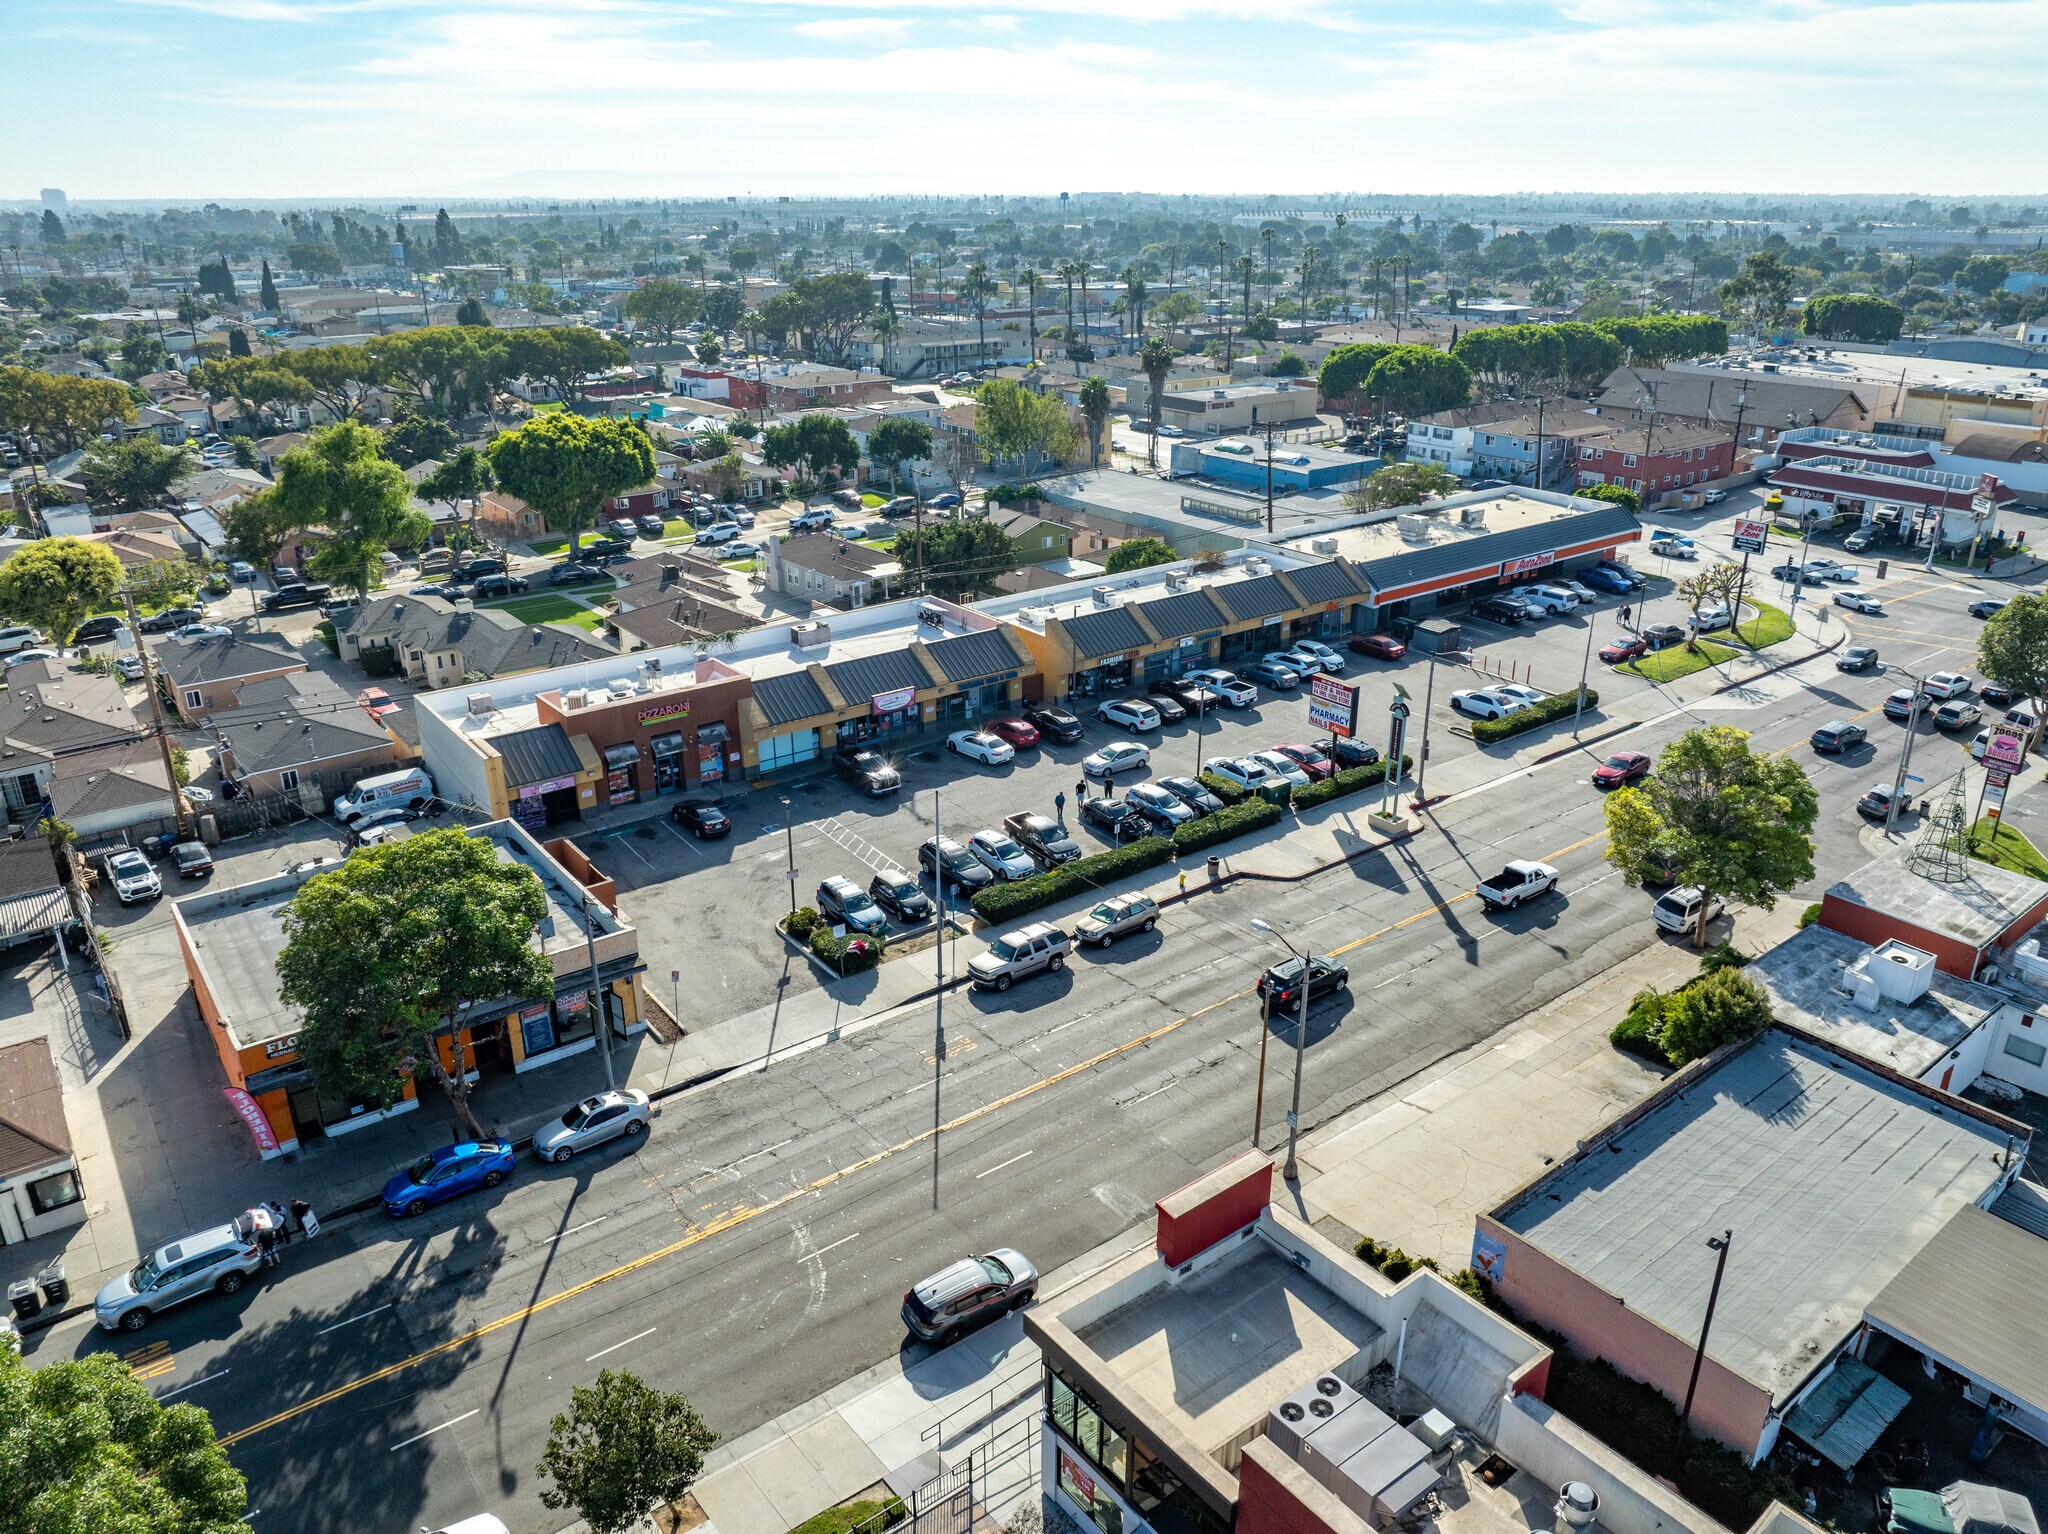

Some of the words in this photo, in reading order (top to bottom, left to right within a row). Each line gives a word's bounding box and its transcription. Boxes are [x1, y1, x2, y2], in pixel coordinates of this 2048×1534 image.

[1740, 529, 1760, 539] Zone
[1745, 523, 1764, 532] Auto
[1517, 554, 1552, 570] AutoZone
[1100, 653, 1124, 666] FASHION
[1313, 681, 1328, 692] BEER
[1336, 688, 1350, 700] WINE
[1310, 705, 1350, 726] PHARMACY
[1310, 715, 1328, 729] NAILS
[1987, 746, 2020, 762] BURGERS
